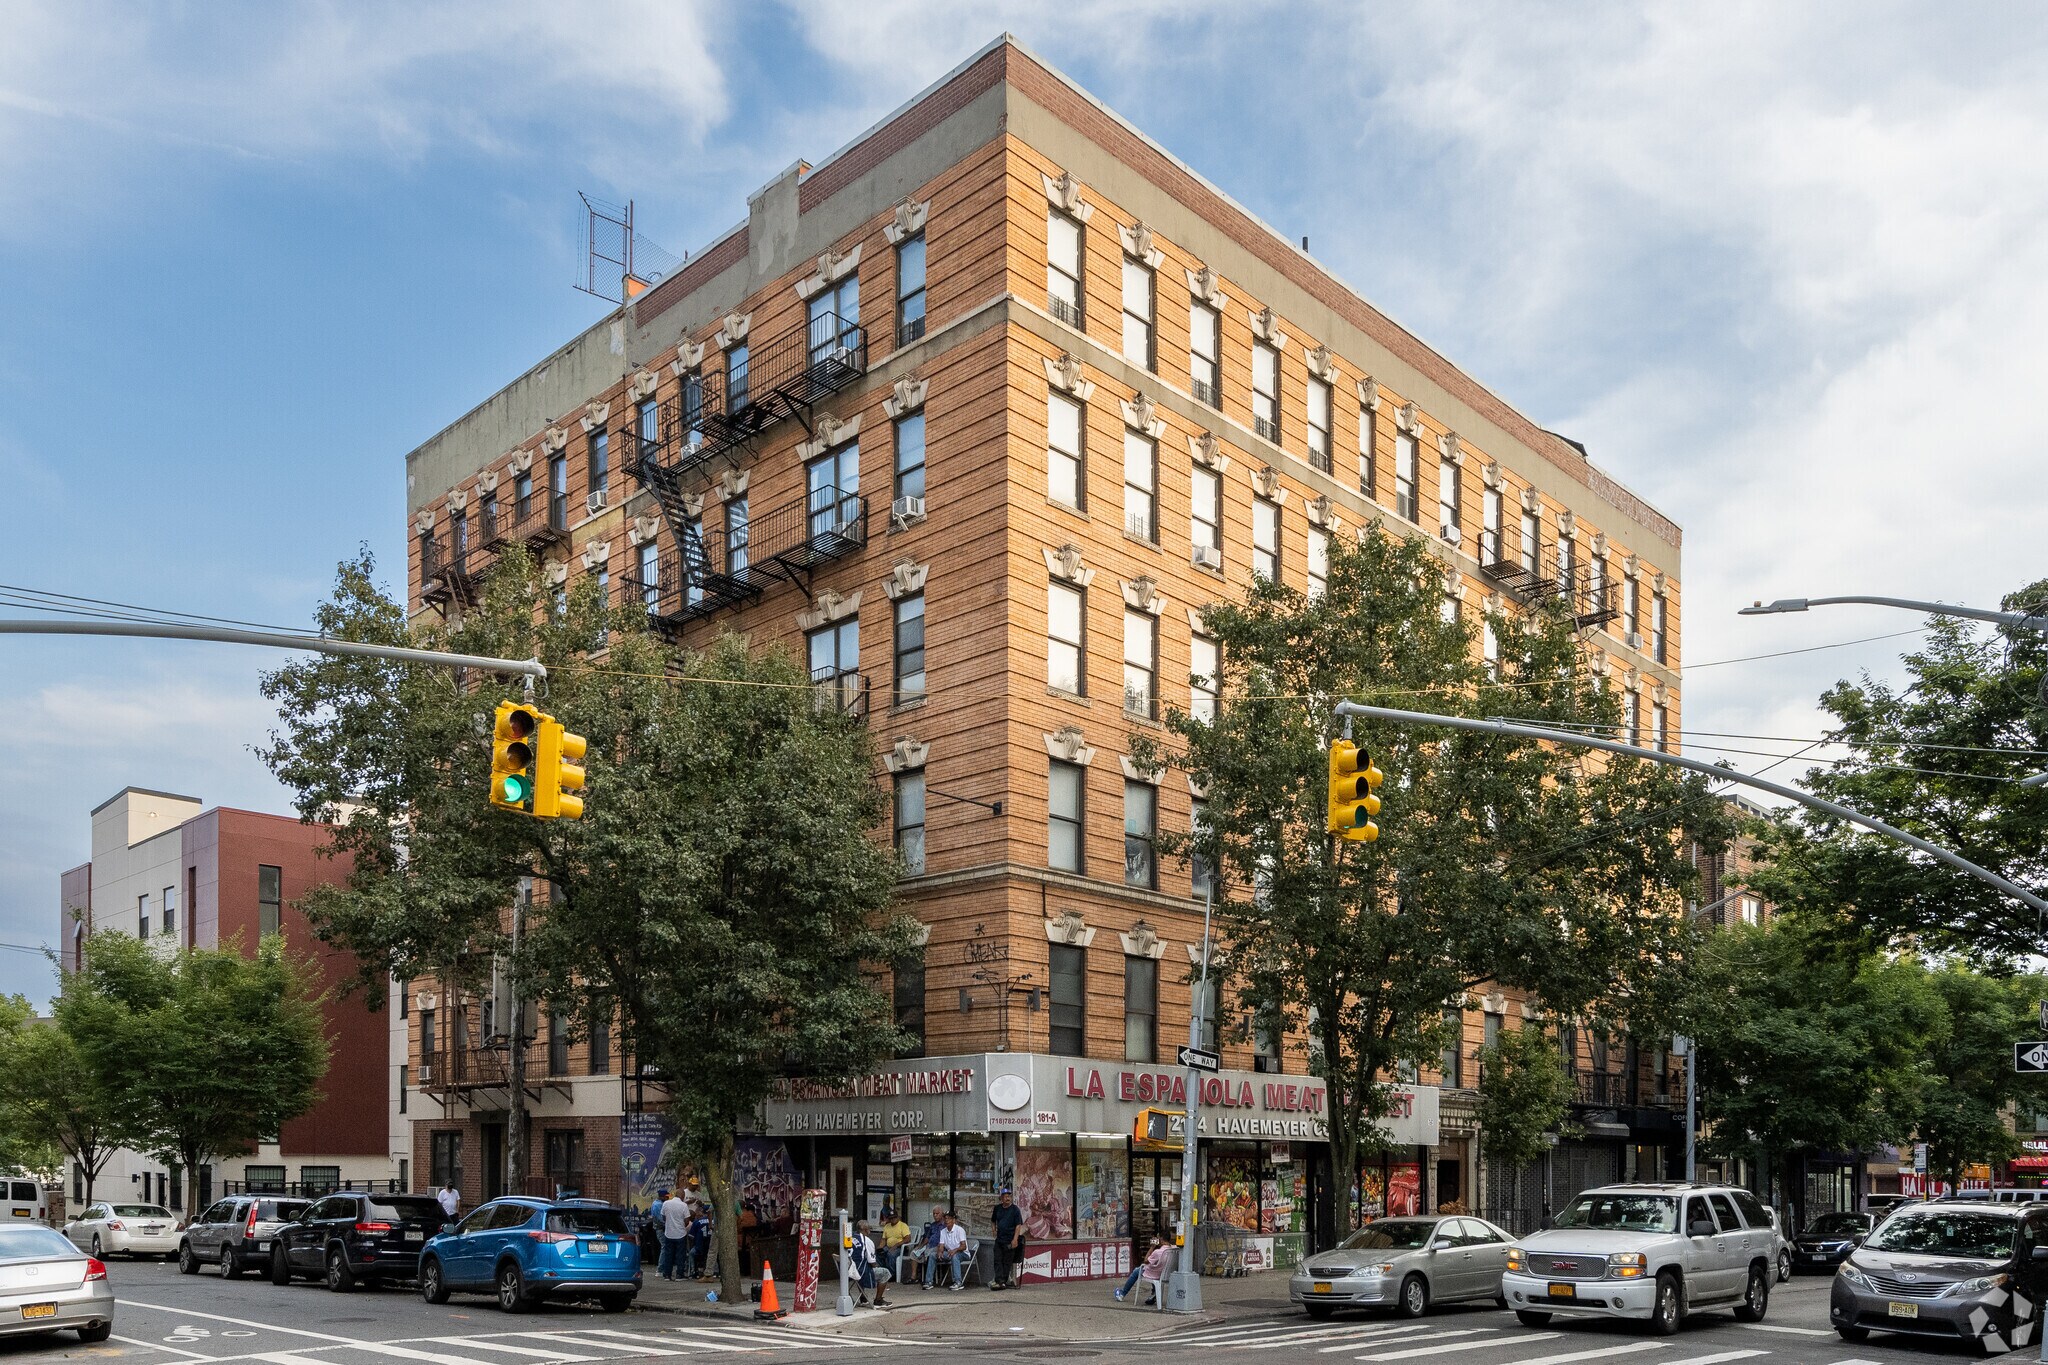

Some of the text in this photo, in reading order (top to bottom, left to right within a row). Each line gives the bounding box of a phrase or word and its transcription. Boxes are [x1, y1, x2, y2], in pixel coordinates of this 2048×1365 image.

[1184, 1053, 1215, 1067] ONE WAY
[2031, 1051, 2048, 1063] ON
[861, 1073, 901, 1097] MEAT
[905, 1068, 974, 1095] MARKET
[1066, 1067, 1106, 1099] LA
[1265, 1083, 1326, 1113] MEAT
[785, 1110, 928, 1130] 2184 HAVEMEYER CORP.
[1171, 1115, 1208, 1132] 214
[1218, 1117, 1308, 1137] HAVEMEYER
[891, 1140, 911, 1153] ATM
[1017, 1260, 1049, 1269] Bdweiser
[1056, 1259, 1063, 1268] LA
[1552, 1261, 1578, 1269] GMC
[1054, 1267, 1088, 1277] MEAT MARKET
